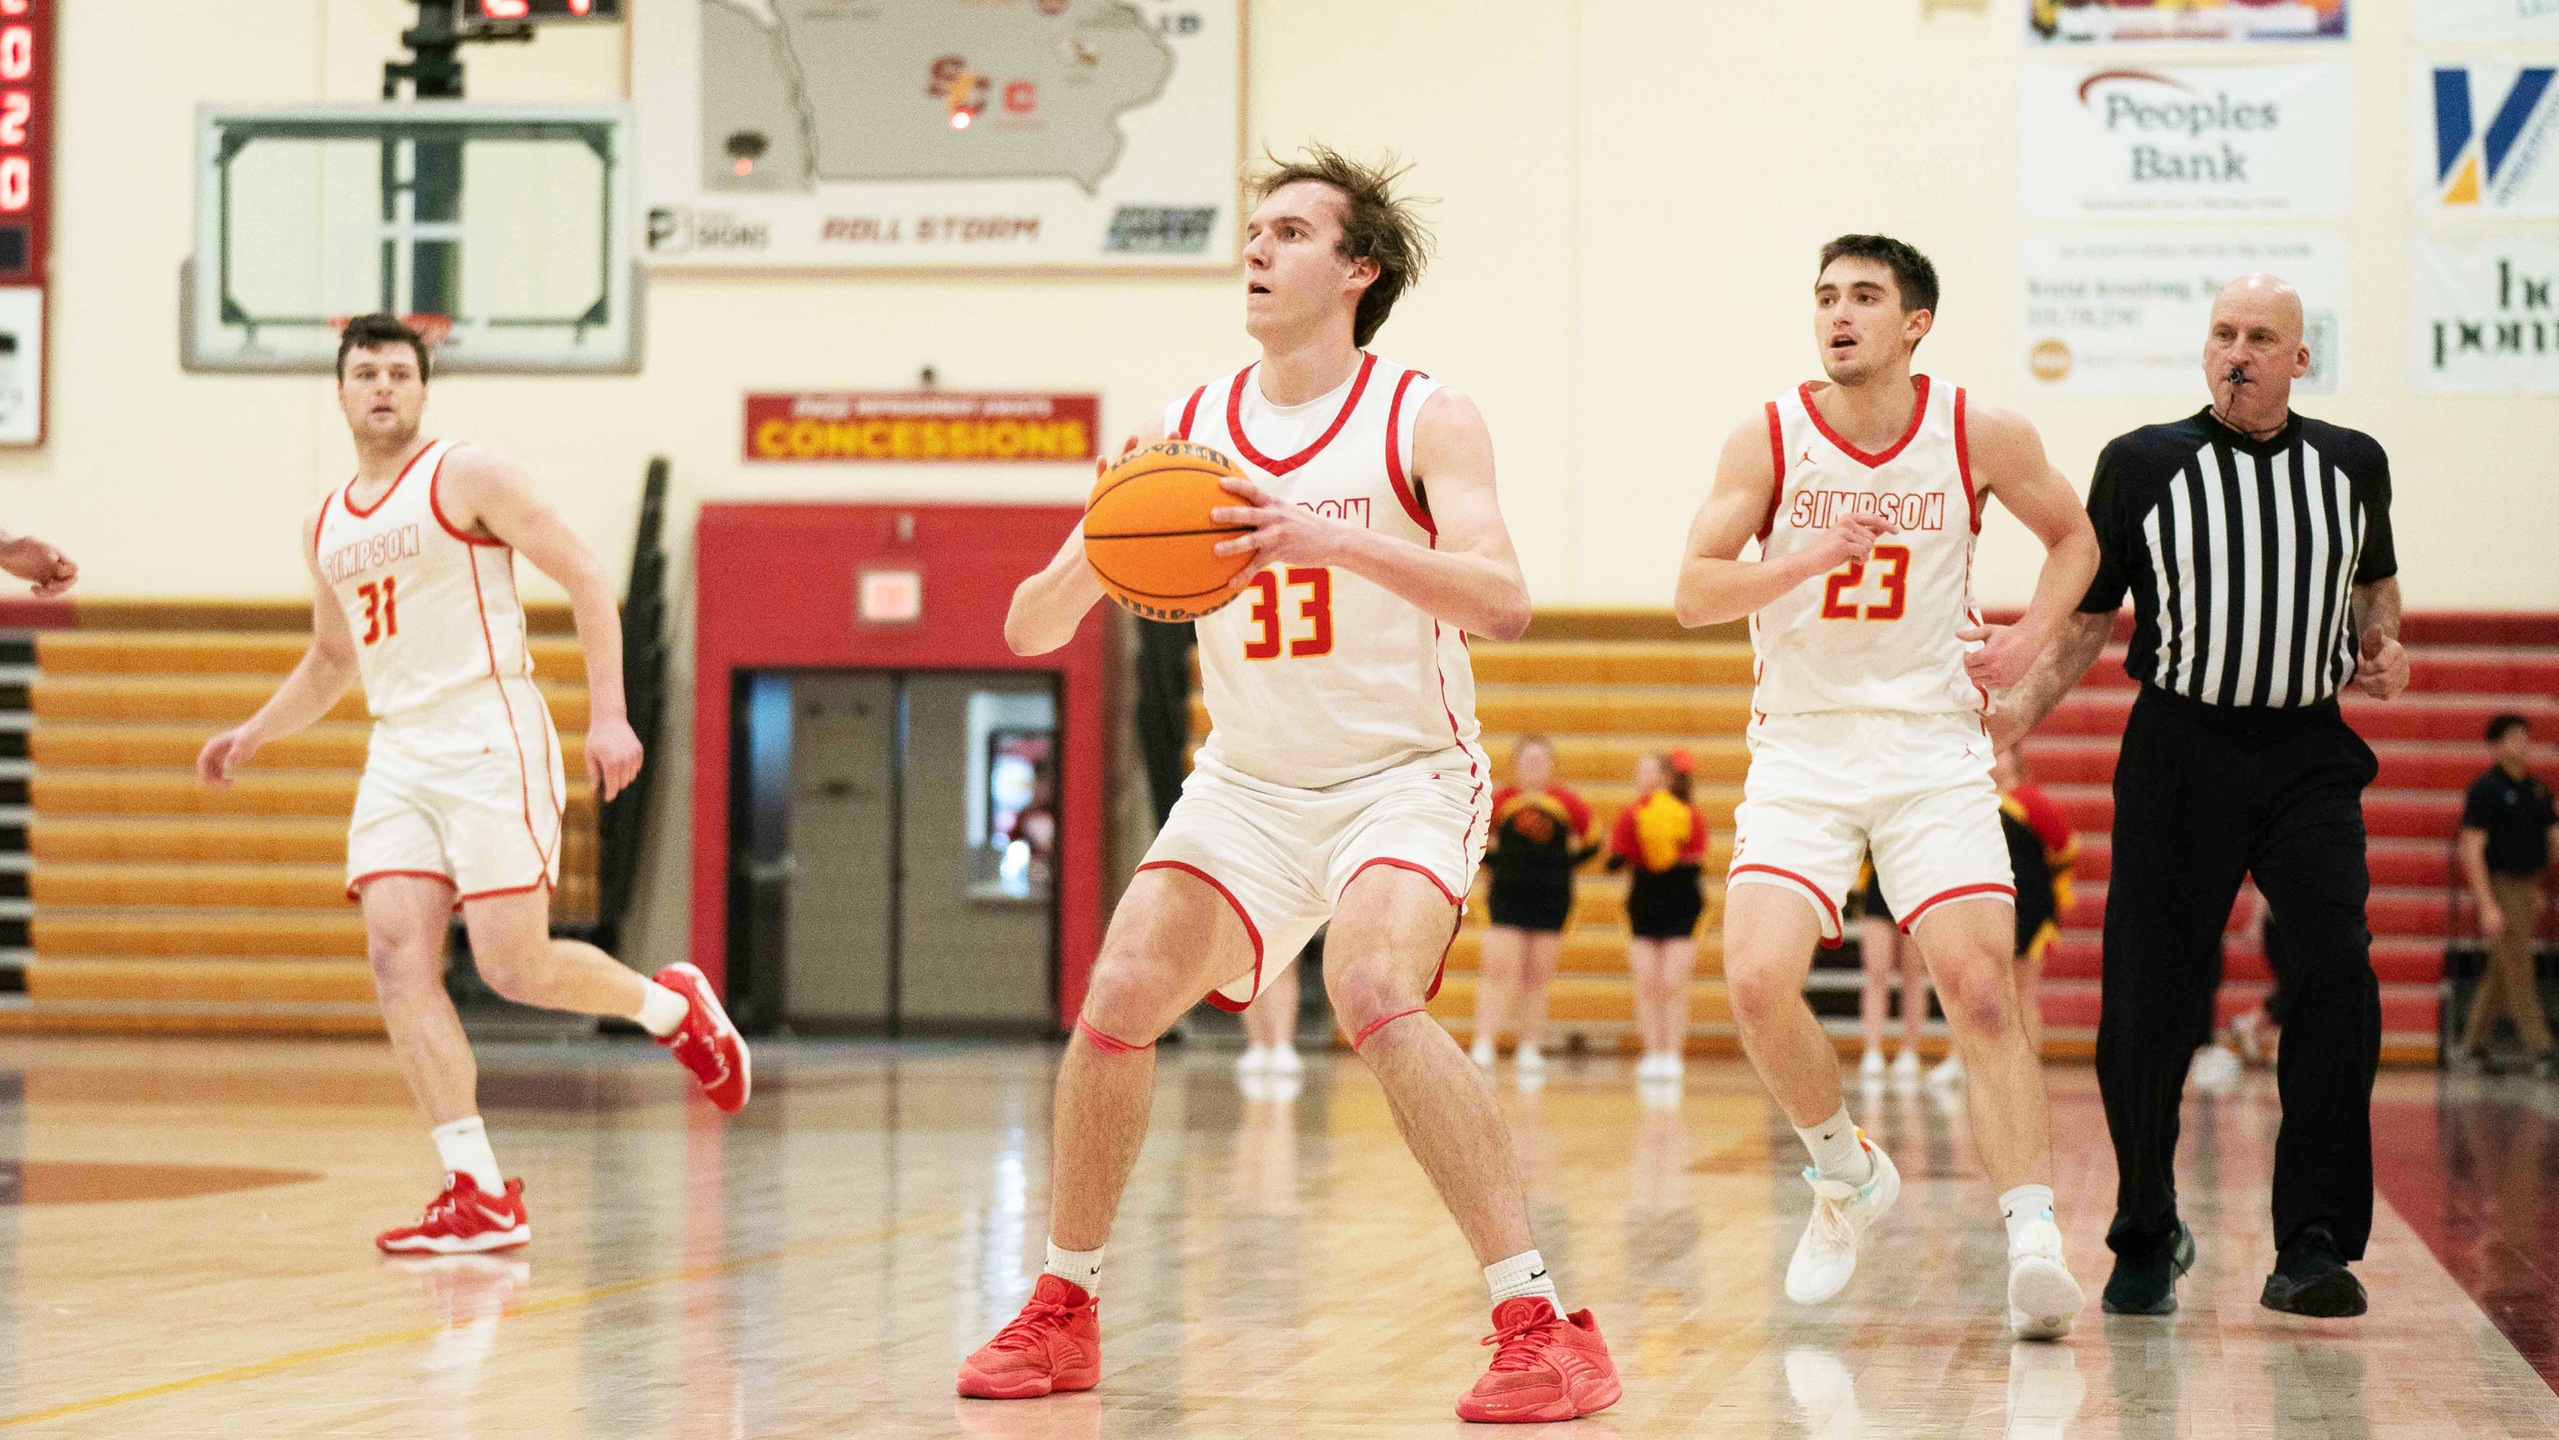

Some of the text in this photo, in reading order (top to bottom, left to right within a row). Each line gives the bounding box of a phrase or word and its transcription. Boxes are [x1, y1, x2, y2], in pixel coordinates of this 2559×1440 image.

[2104, 91, 2280, 138] Peoples
[2131, 142, 2248, 182] Bank
[822, 217, 903, 241] ROLL
[755, 418, 1089, 459] CONCESSIONS
[1820, 543, 1911, 621] 23
[356, 575, 398, 647] 31
[1243, 565, 1335, 662] 33
